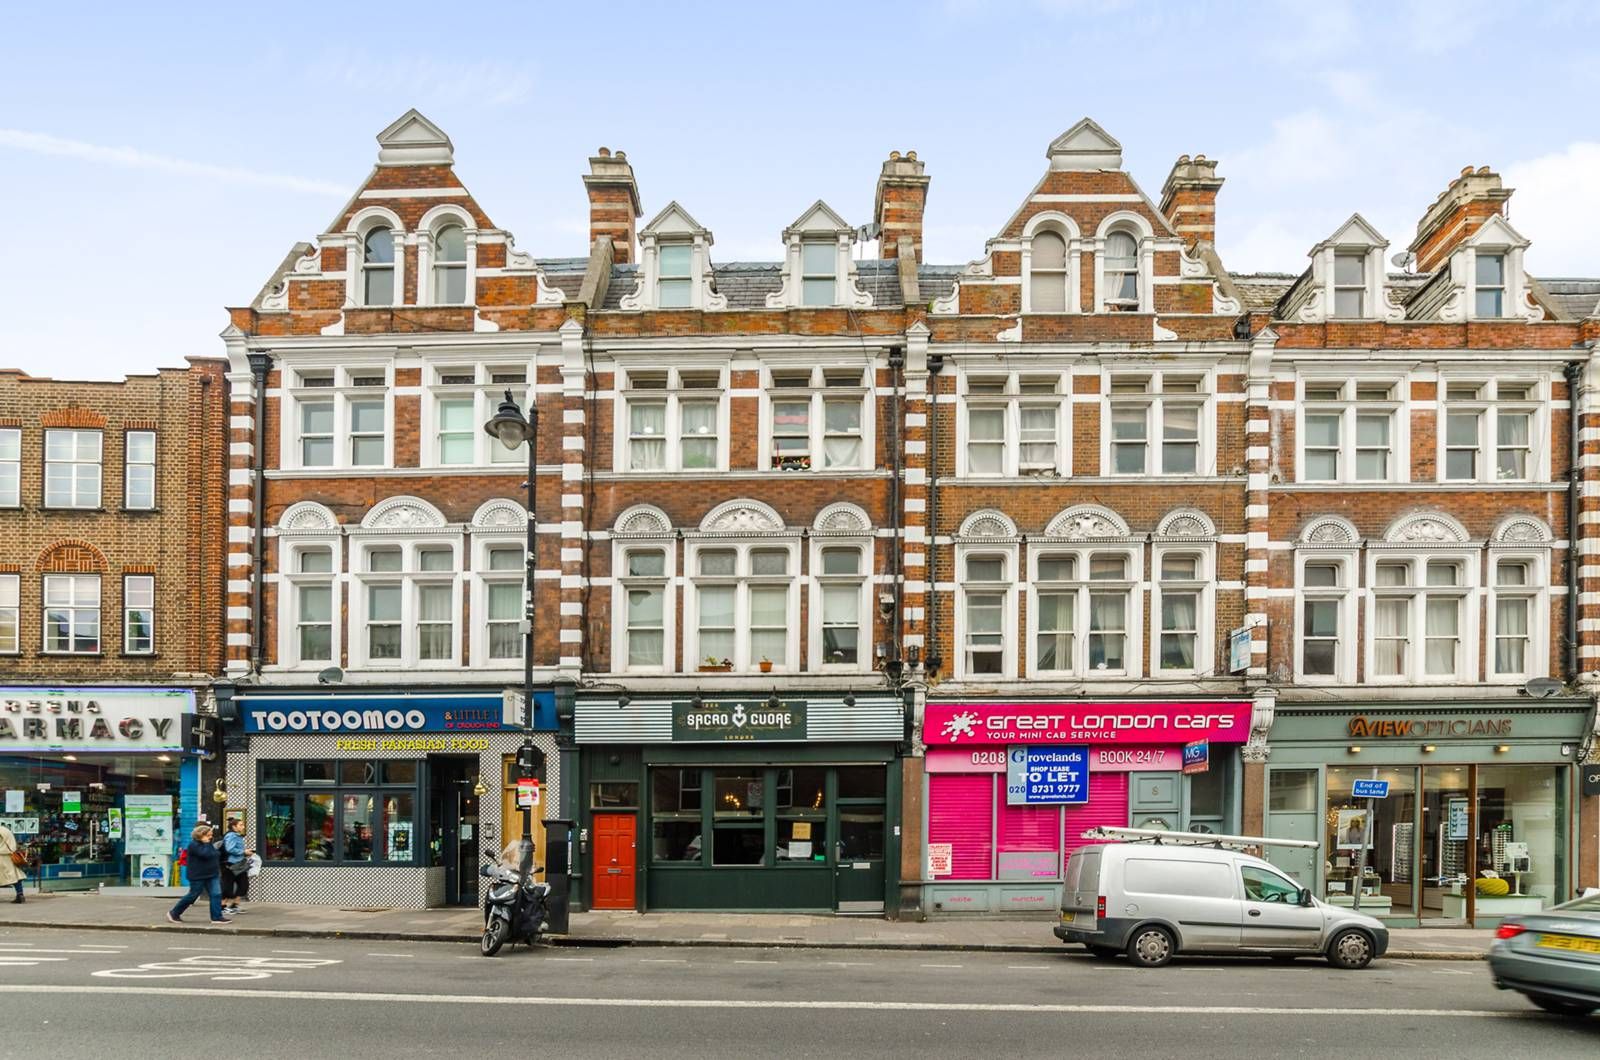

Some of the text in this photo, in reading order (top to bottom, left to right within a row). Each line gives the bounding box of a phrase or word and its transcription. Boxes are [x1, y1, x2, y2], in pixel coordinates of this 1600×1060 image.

[251, 709, 426, 731] TOOTOOMOO
[687, 713, 792, 730] SACRO CUORE
[1046, 731, 1067, 739] CAB
[1071, 731, 1117, 739] SERVICE
[336, 738, 489, 750] FRESH PANASIAN FOOD
[972, 752, 1006, 764] 0208
[1011, 749, 1082, 763] Grovelands
[1100, 750, 1165, 763] BOOK 24/7
[1185, 747, 1200, 760] MG
[1018, 772, 1079, 782] TO LET
[1008, 785, 1080, 794] 020 8731 9777
